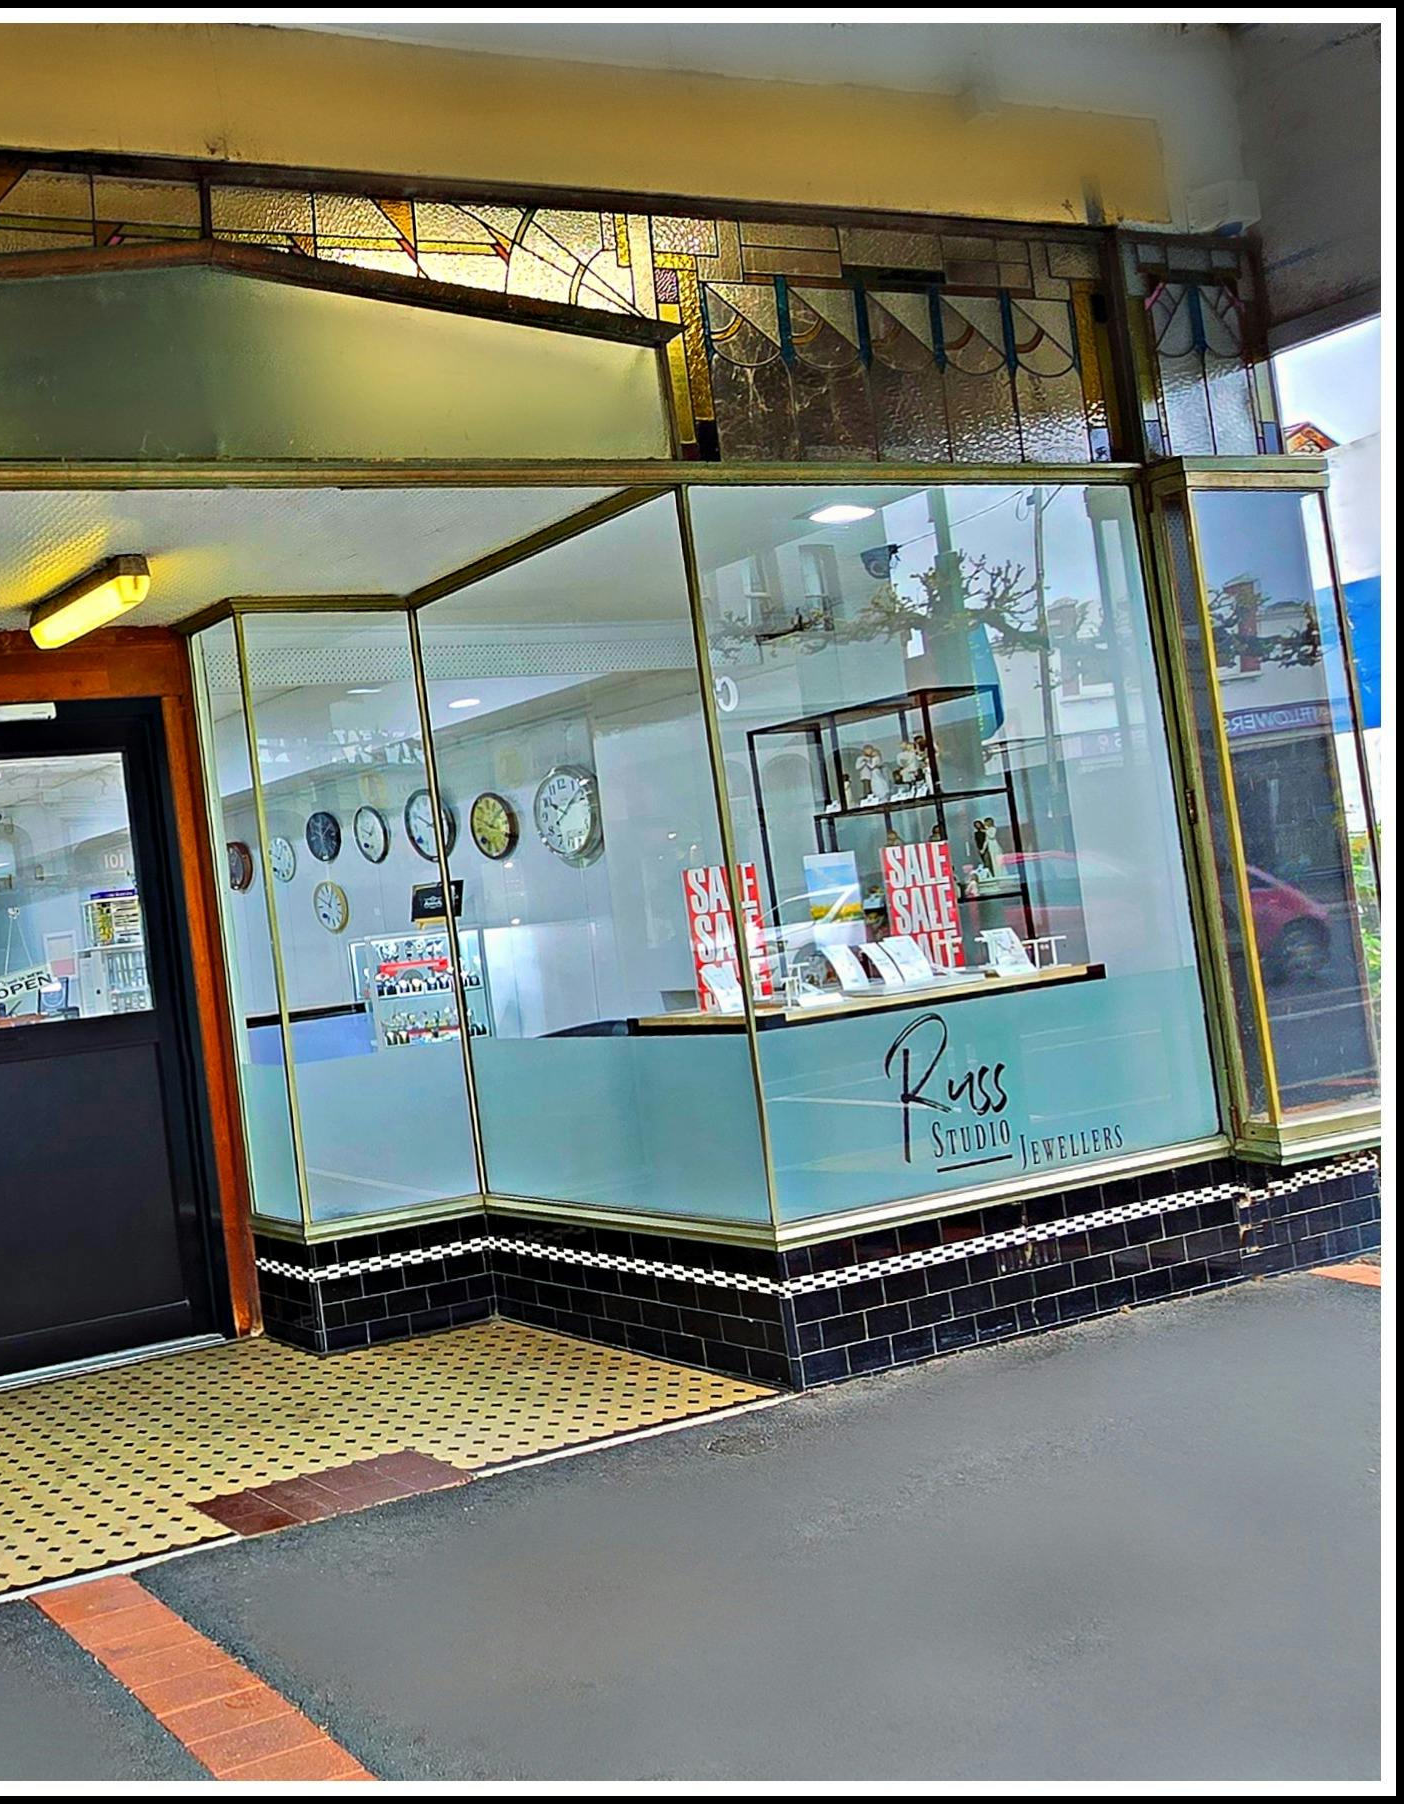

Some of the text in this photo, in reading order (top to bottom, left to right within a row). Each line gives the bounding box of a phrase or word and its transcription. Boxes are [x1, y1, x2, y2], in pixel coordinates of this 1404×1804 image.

[687, 863, 758, 914] SAE
[886, 842, 950, 889] SALE
[892, 885, 957, 935] SALE
[885, 1013, 1008, 1164] Russ
[931, 1120, 1124, 1170] STUDIO JEWELLERS
